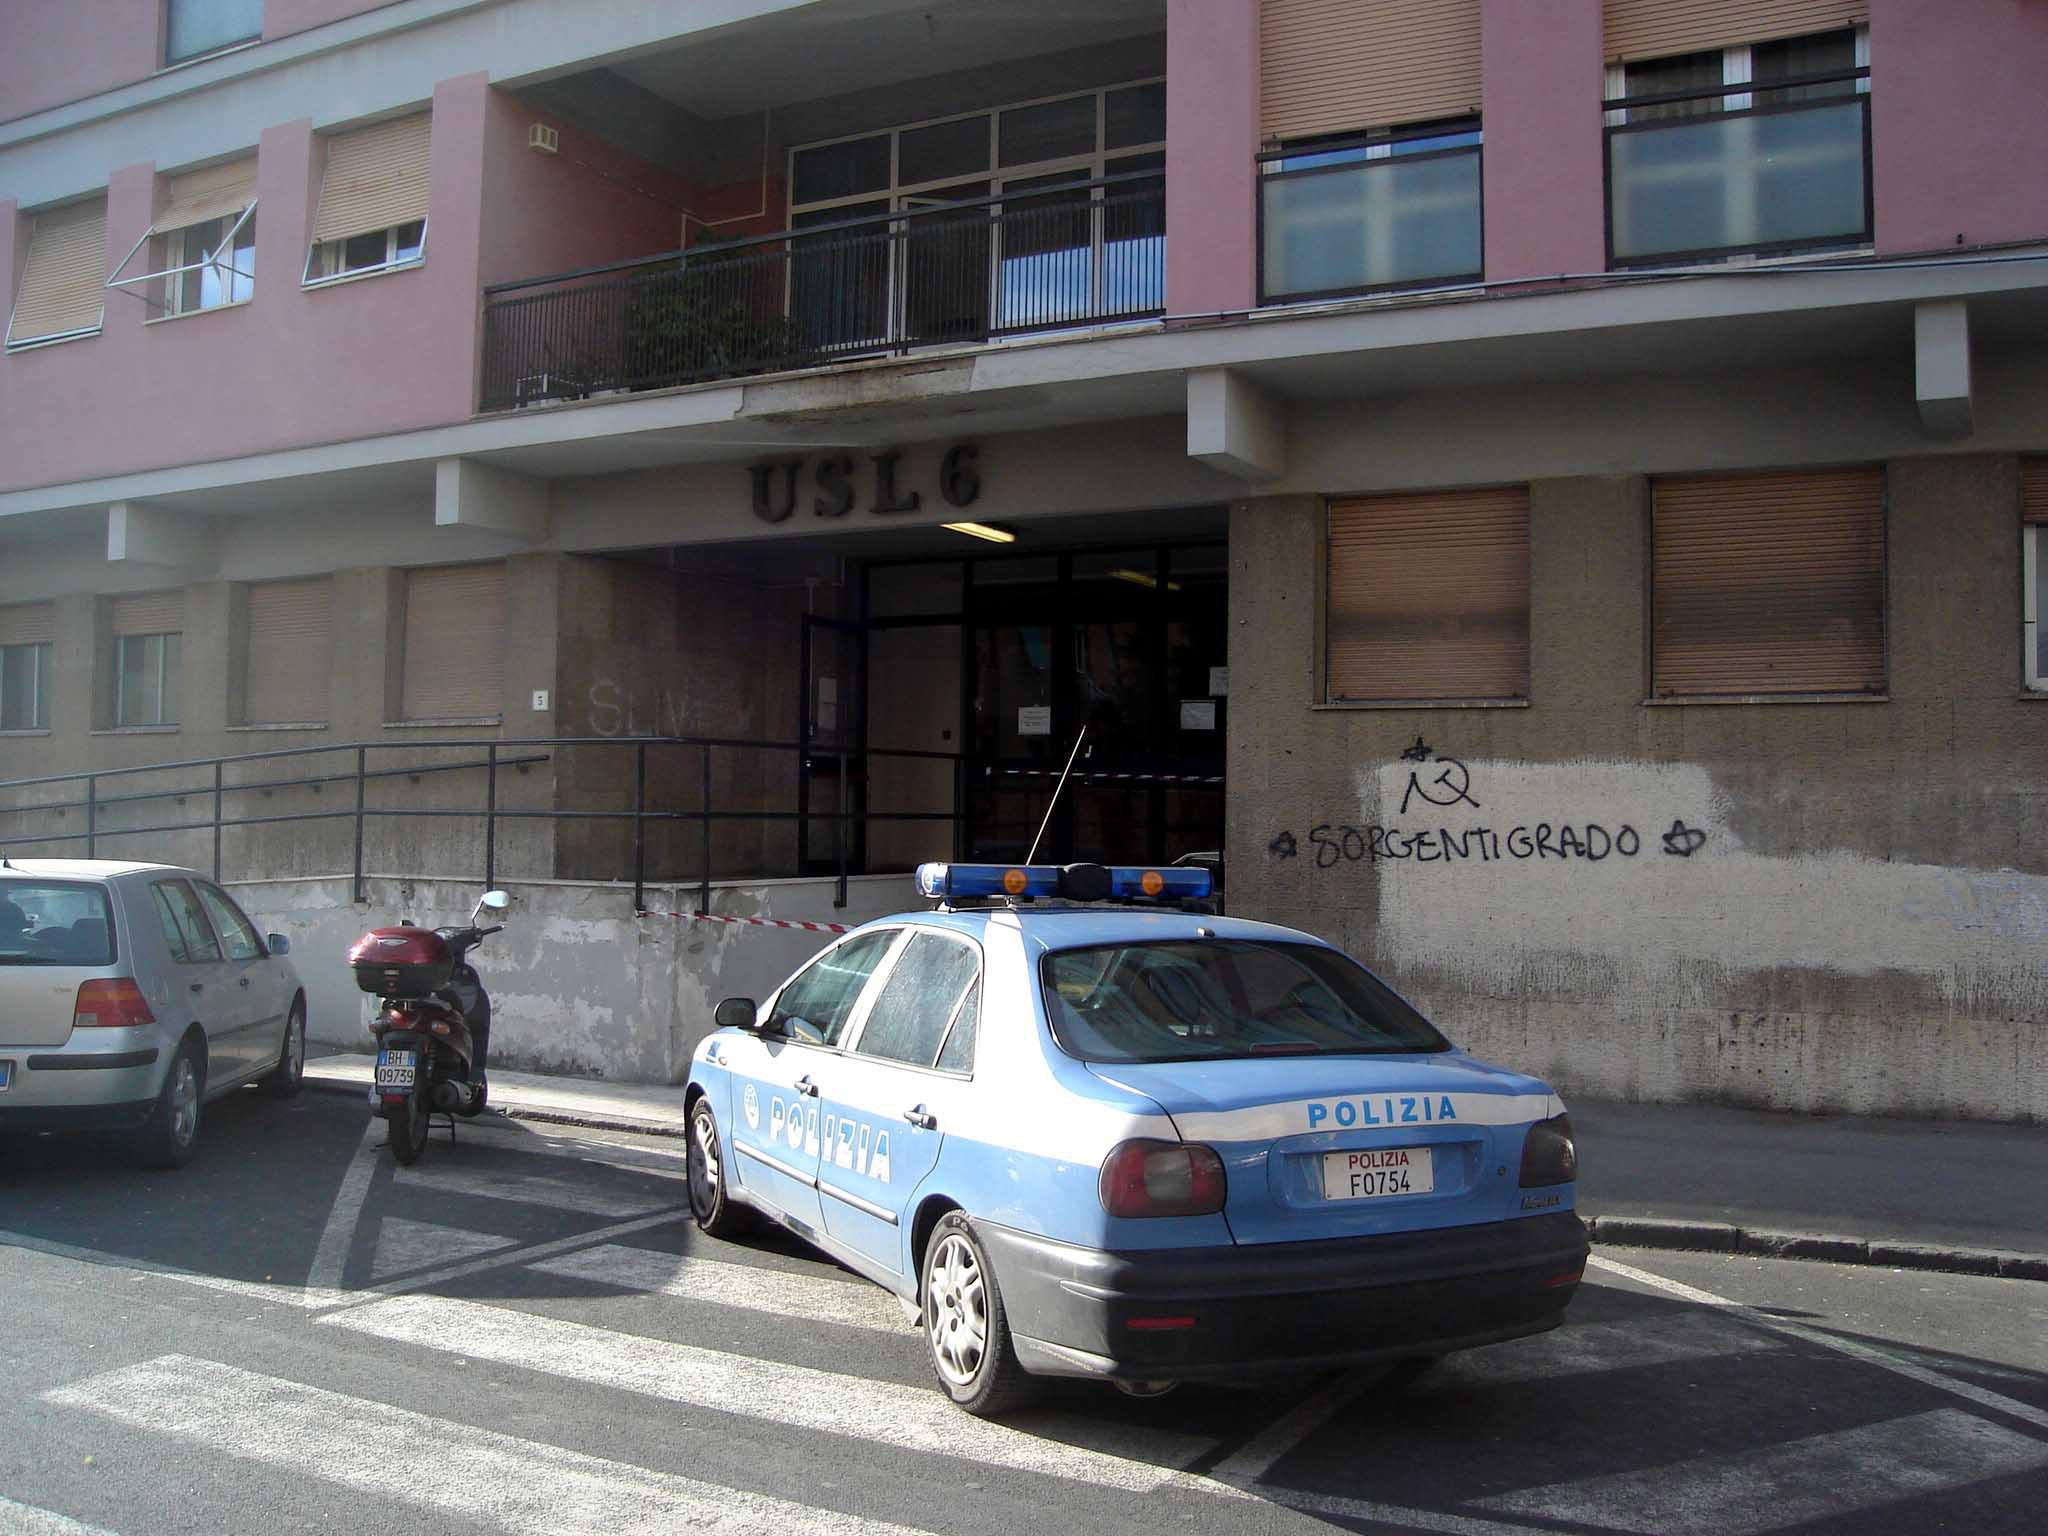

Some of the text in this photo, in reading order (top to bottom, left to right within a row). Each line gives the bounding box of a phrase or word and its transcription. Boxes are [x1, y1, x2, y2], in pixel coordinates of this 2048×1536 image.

[748, 445, 981, 524] USL 6
[388, 1051, 402, 1065] BH
[1307, 1096, 1457, 1129] POLIZIA
[769, 1096, 892, 1184] POLIZIA
[1349, 1151, 1410, 1169] POLIZIA
[1350, 1170, 1411, 1197] F0754
